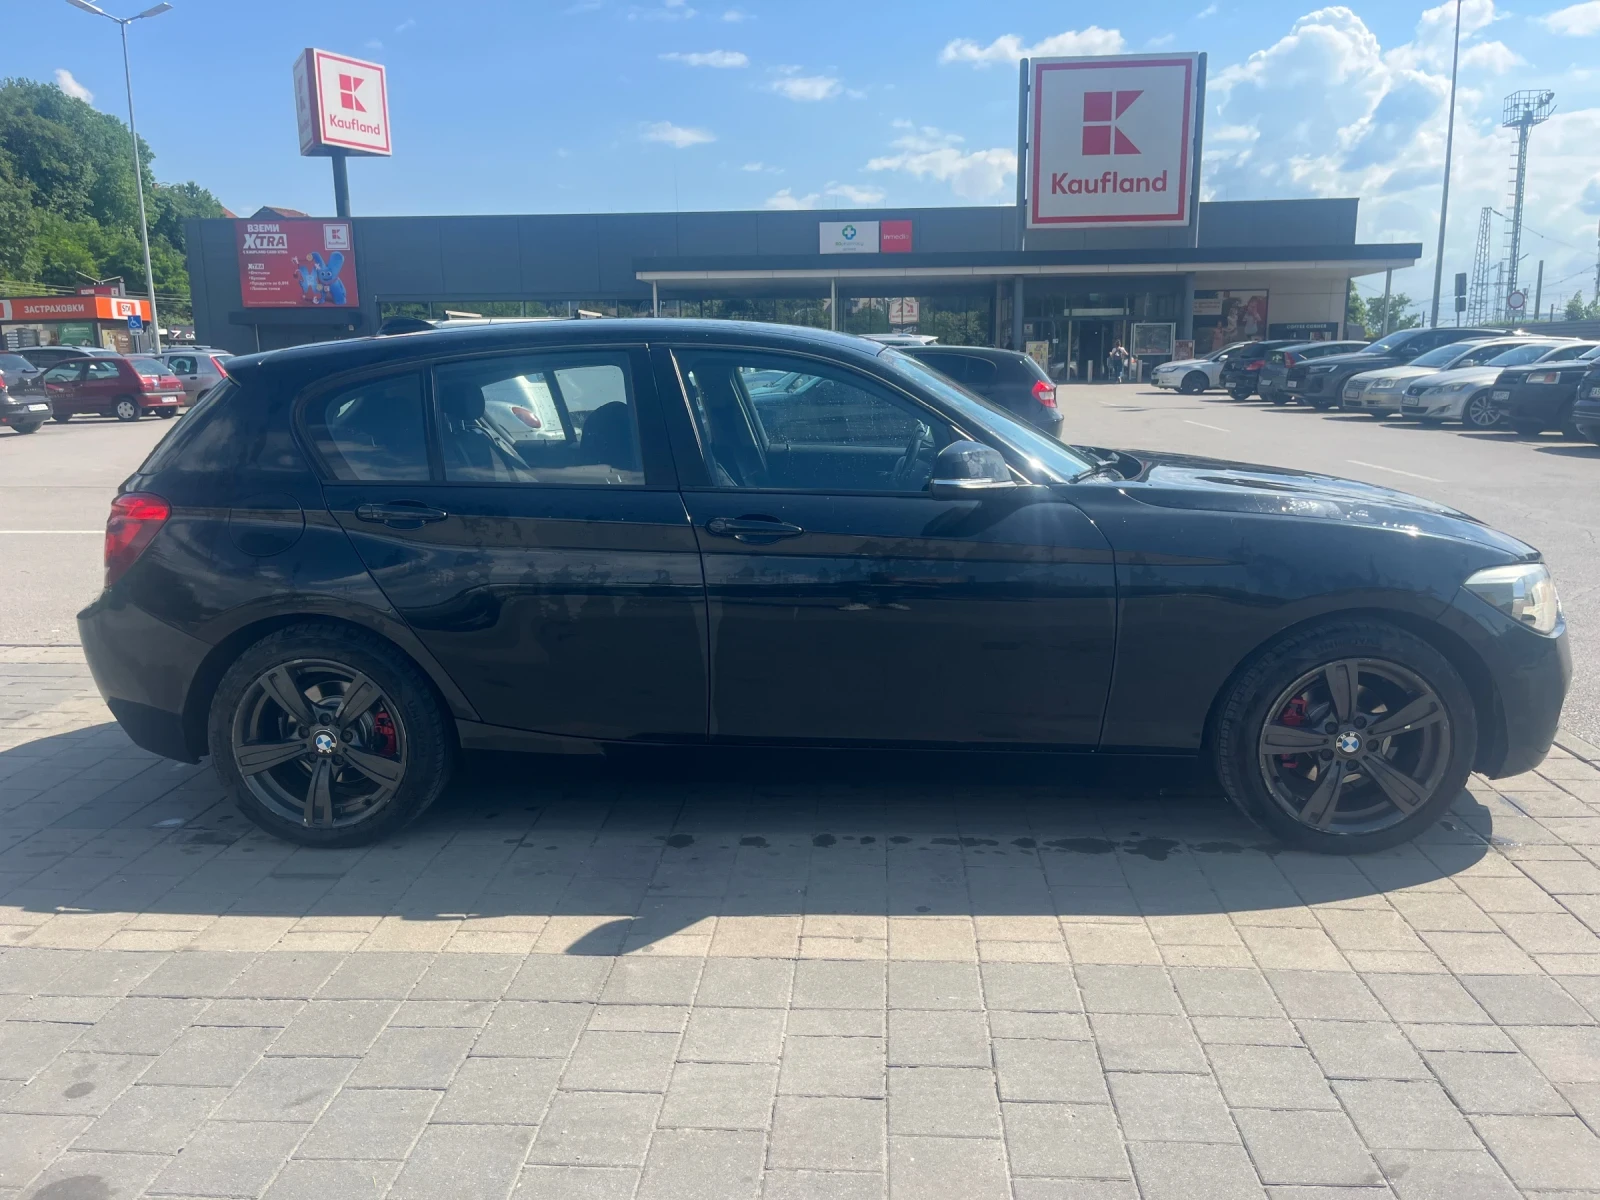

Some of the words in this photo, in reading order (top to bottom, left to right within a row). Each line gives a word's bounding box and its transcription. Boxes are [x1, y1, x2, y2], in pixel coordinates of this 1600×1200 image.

[339, 73, 367, 113] K
[329, 114, 381, 136] Kaufland
[1082, 90, 1144, 156] K
[1051, 169, 1168, 195] Kaufland
[247, 224, 280, 233] ВЗЕМИ
[243, 233, 288, 249] XTRA
[24, 303, 85, 314] ЗАСТРАХОВКИ
